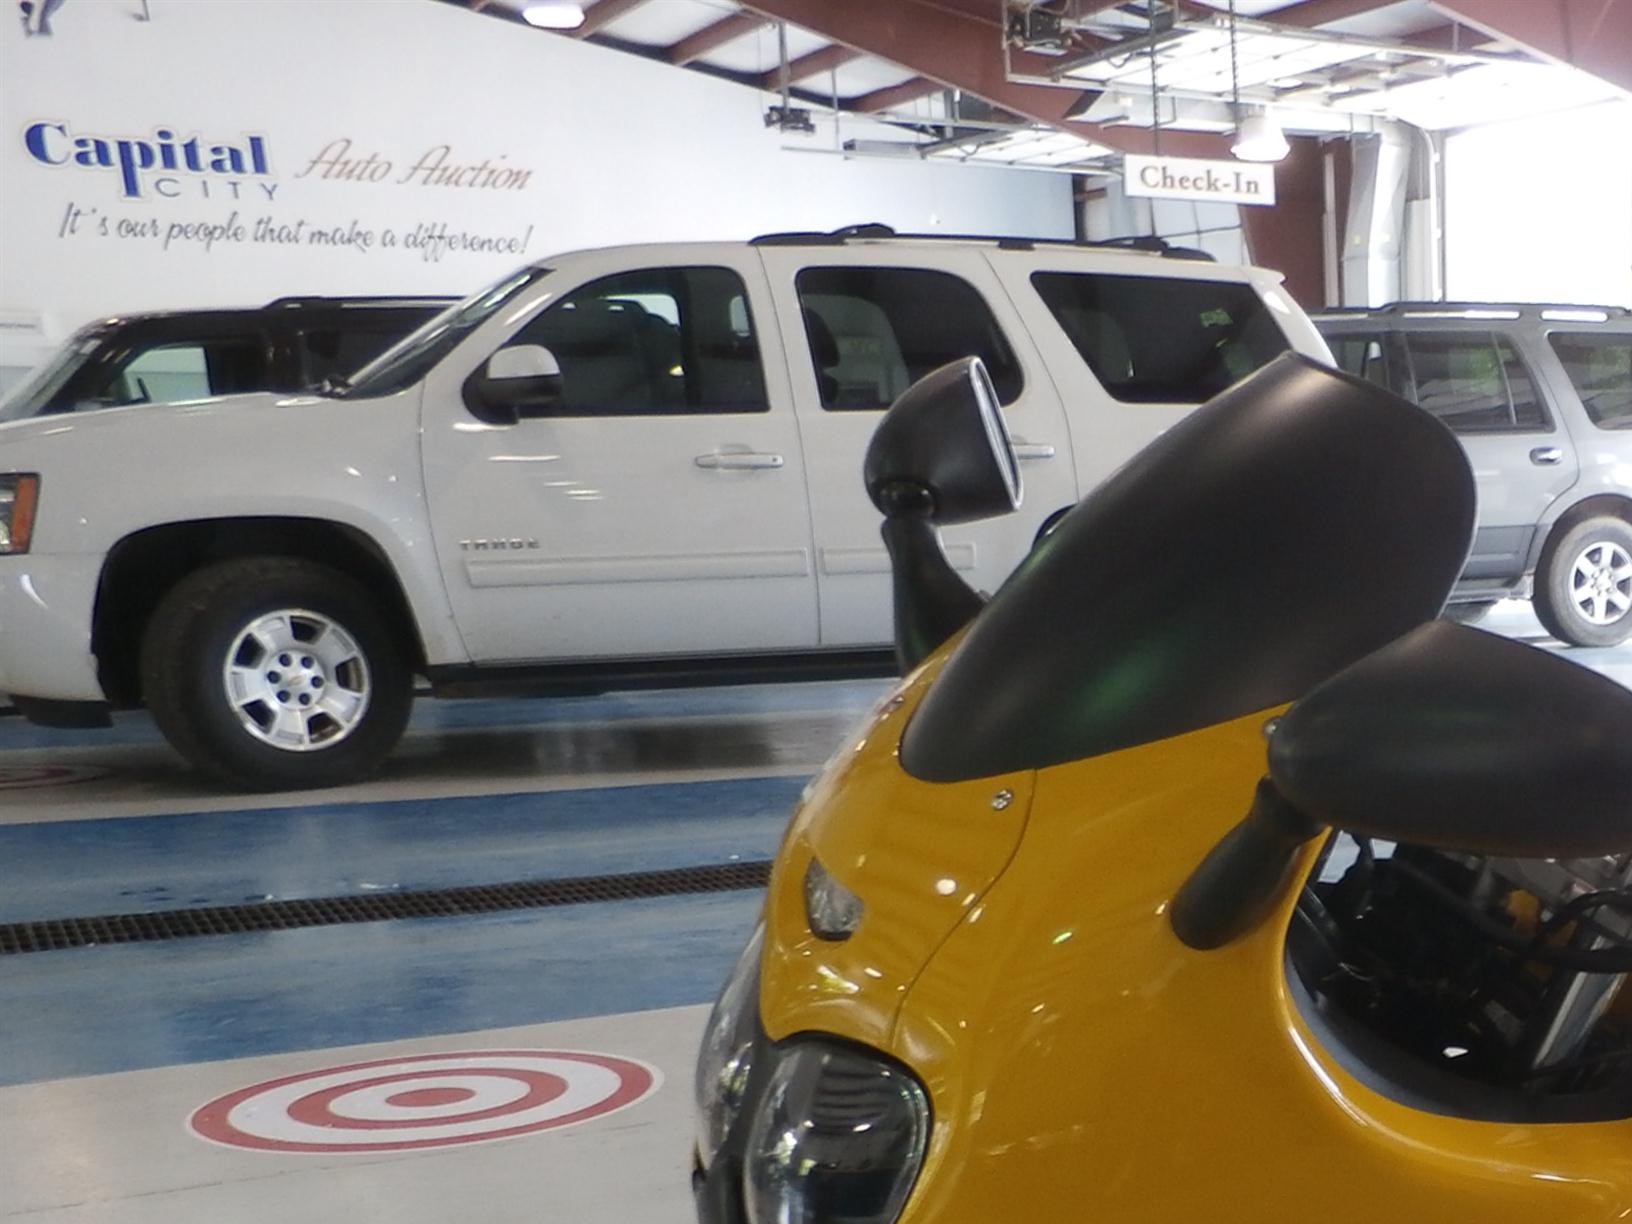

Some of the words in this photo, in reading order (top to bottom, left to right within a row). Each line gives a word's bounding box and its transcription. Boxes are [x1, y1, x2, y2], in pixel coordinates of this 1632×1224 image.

[25, 122, 269, 198] Capital
[294, 138, 392, 182] Auto
[397, 145, 532, 190] Auction
[1140, 165, 1260, 194] Check-In
[155, 178, 278, 200] CITY
[58, 202, 109, 238] It's
[116, 218, 160, 238] our
[164, 211, 246, 251] people
[252, 215, 304, 244] that
[309, 219, 374, 252] make
[381, 229, 396, 247] a
[404, 222, 534, 262] difference!
